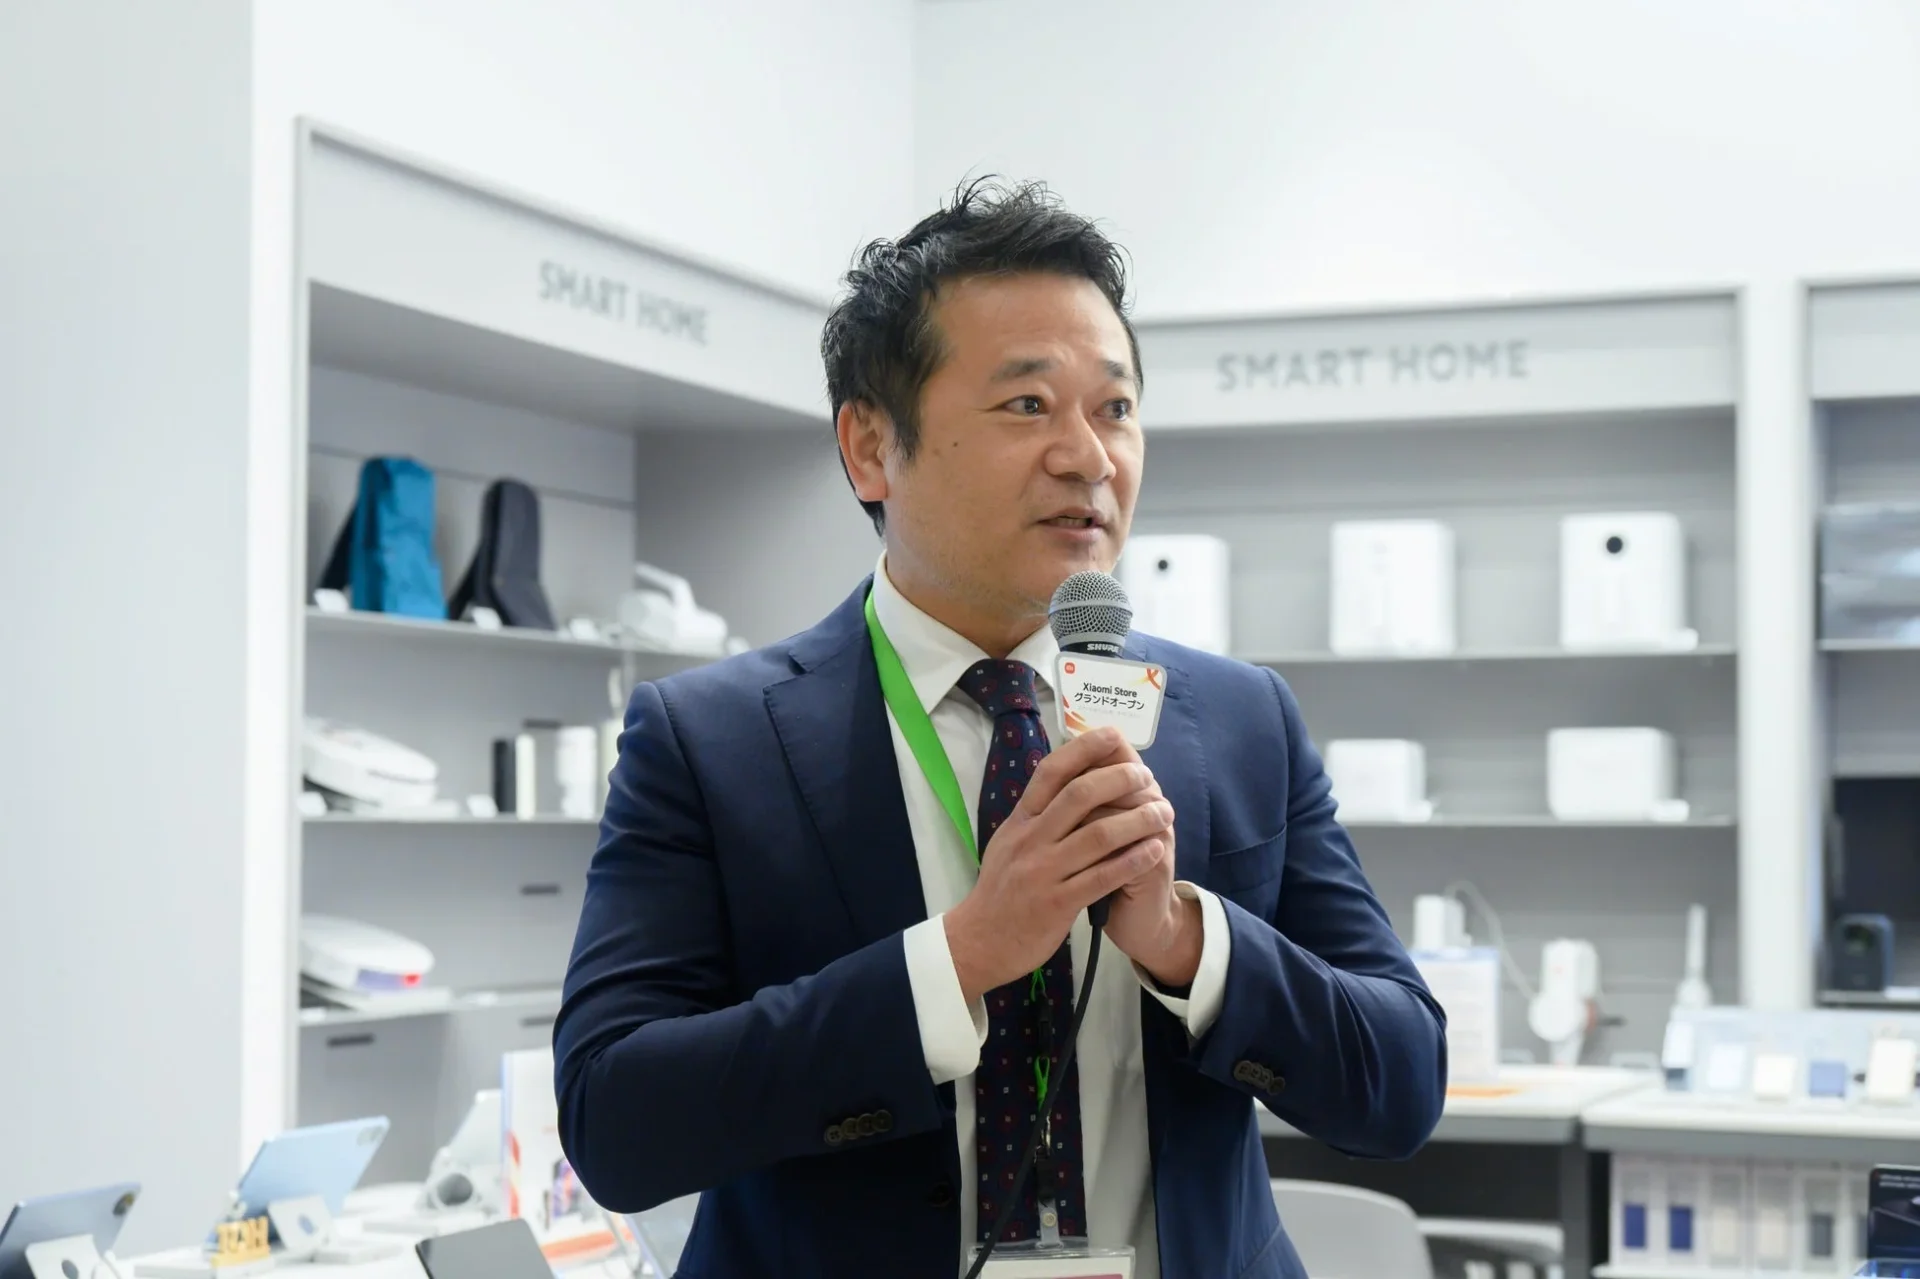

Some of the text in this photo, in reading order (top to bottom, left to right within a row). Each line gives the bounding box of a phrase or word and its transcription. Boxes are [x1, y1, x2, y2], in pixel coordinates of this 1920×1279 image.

[538, 260, 709, 348] SMART HOME
[1215, 339, 1531, 391] SMART HOME
[1087, 643, 1119, 653] SHURE
[1083, 682, 1138, 698] Xiaomi Store
[1074, 692, 1145, 710] グランドオープン
